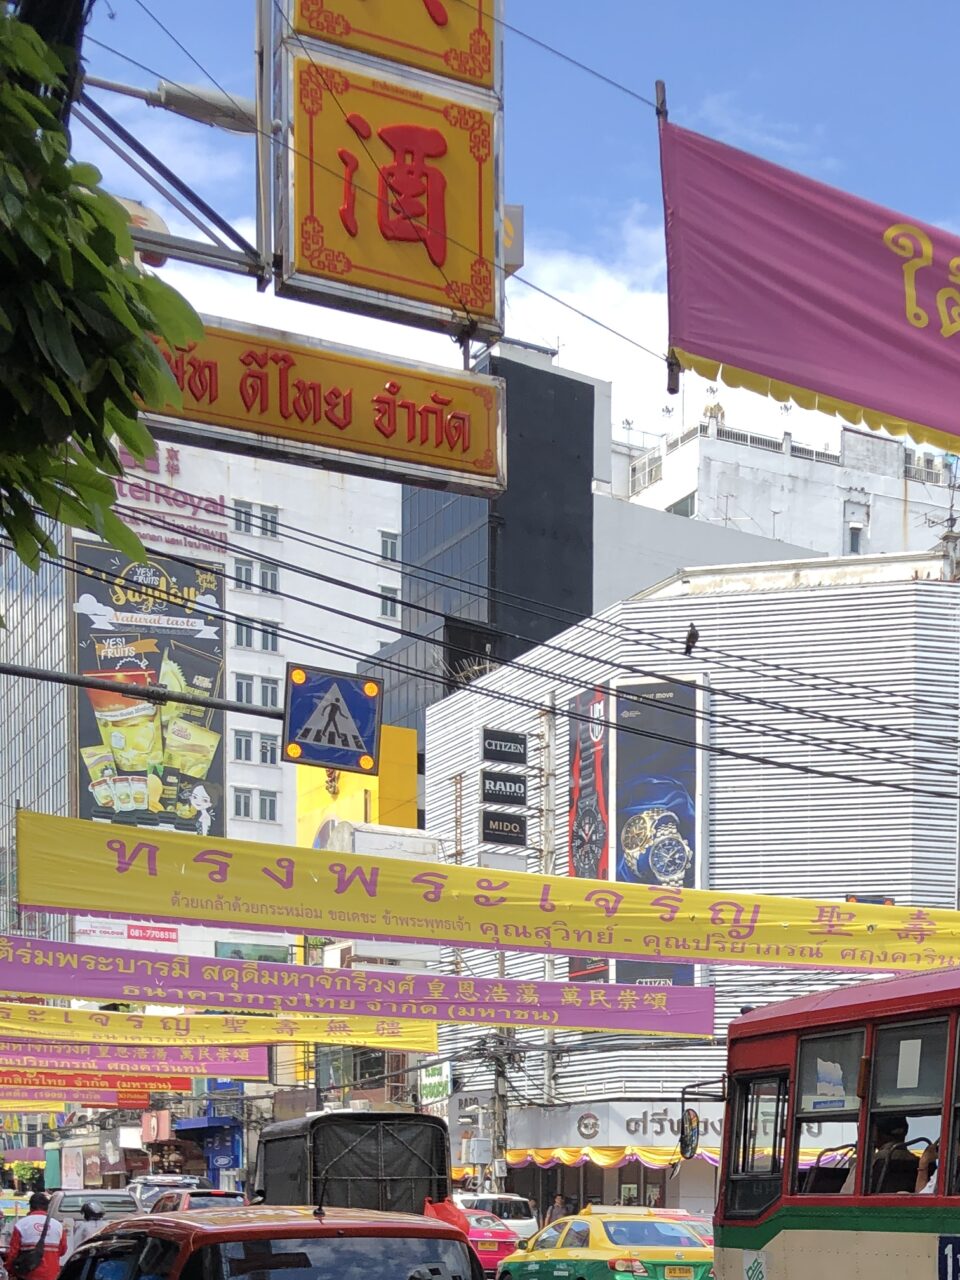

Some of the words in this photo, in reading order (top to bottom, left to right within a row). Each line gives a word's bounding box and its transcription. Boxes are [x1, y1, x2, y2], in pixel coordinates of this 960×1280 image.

[338, 113, 447, 267] 酒
[239, 350, 352, 431] ดีไทย
[372, 380, 471, 452] จำกัด
[102, 636, 126, 649] YES!
[101, 647, 136, 660] FRUITS
[485, 739, 525, 754] CITIZEN
[484, 779, 525, 794] RADO
[489, 820, 520, 833] MIDO
[944, 1244, 953, 1280] 1
